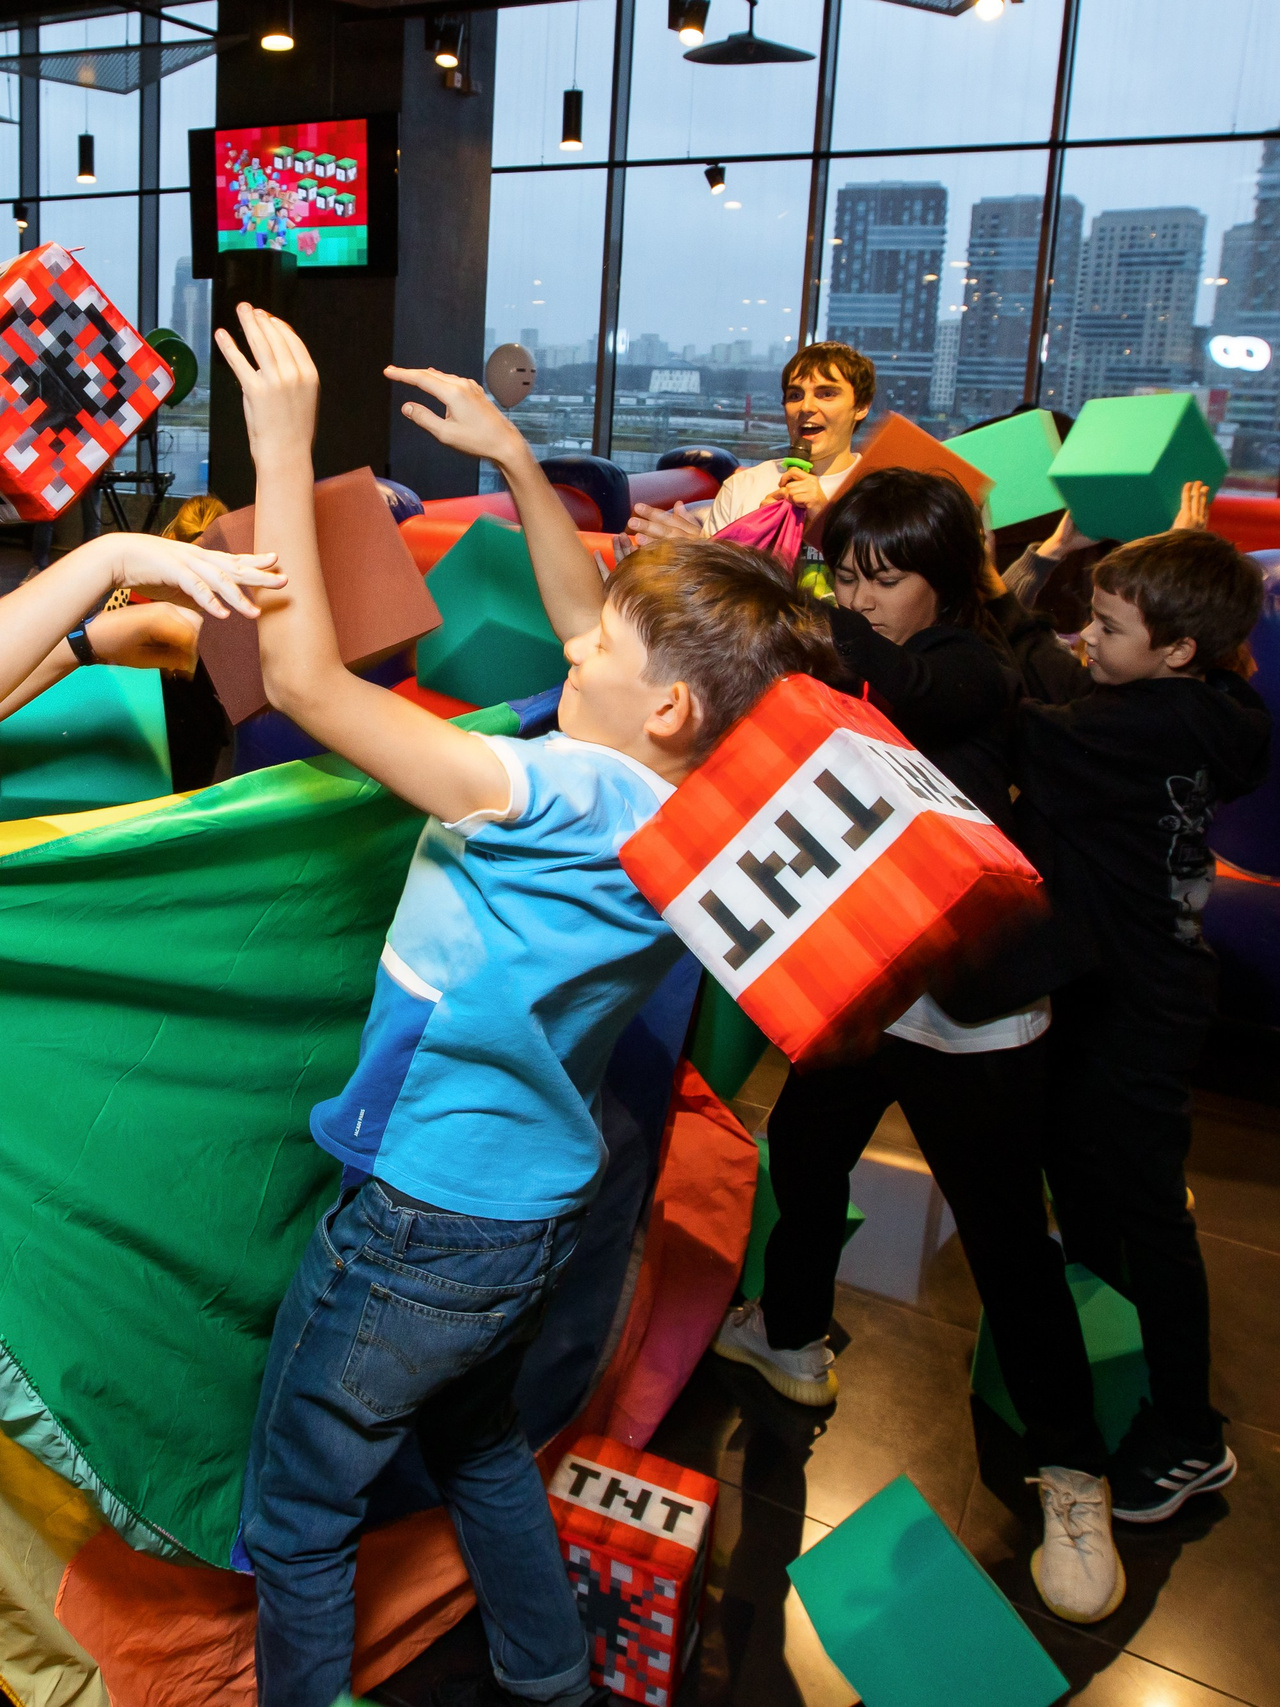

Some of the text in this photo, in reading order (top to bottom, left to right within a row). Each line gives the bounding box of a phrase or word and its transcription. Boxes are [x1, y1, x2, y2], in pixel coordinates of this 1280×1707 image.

[273, 154, 358, 182] BIRTHDAY
[698, 768, 895, 971] TNT
[568, 1461, 694, 1533] TNT
